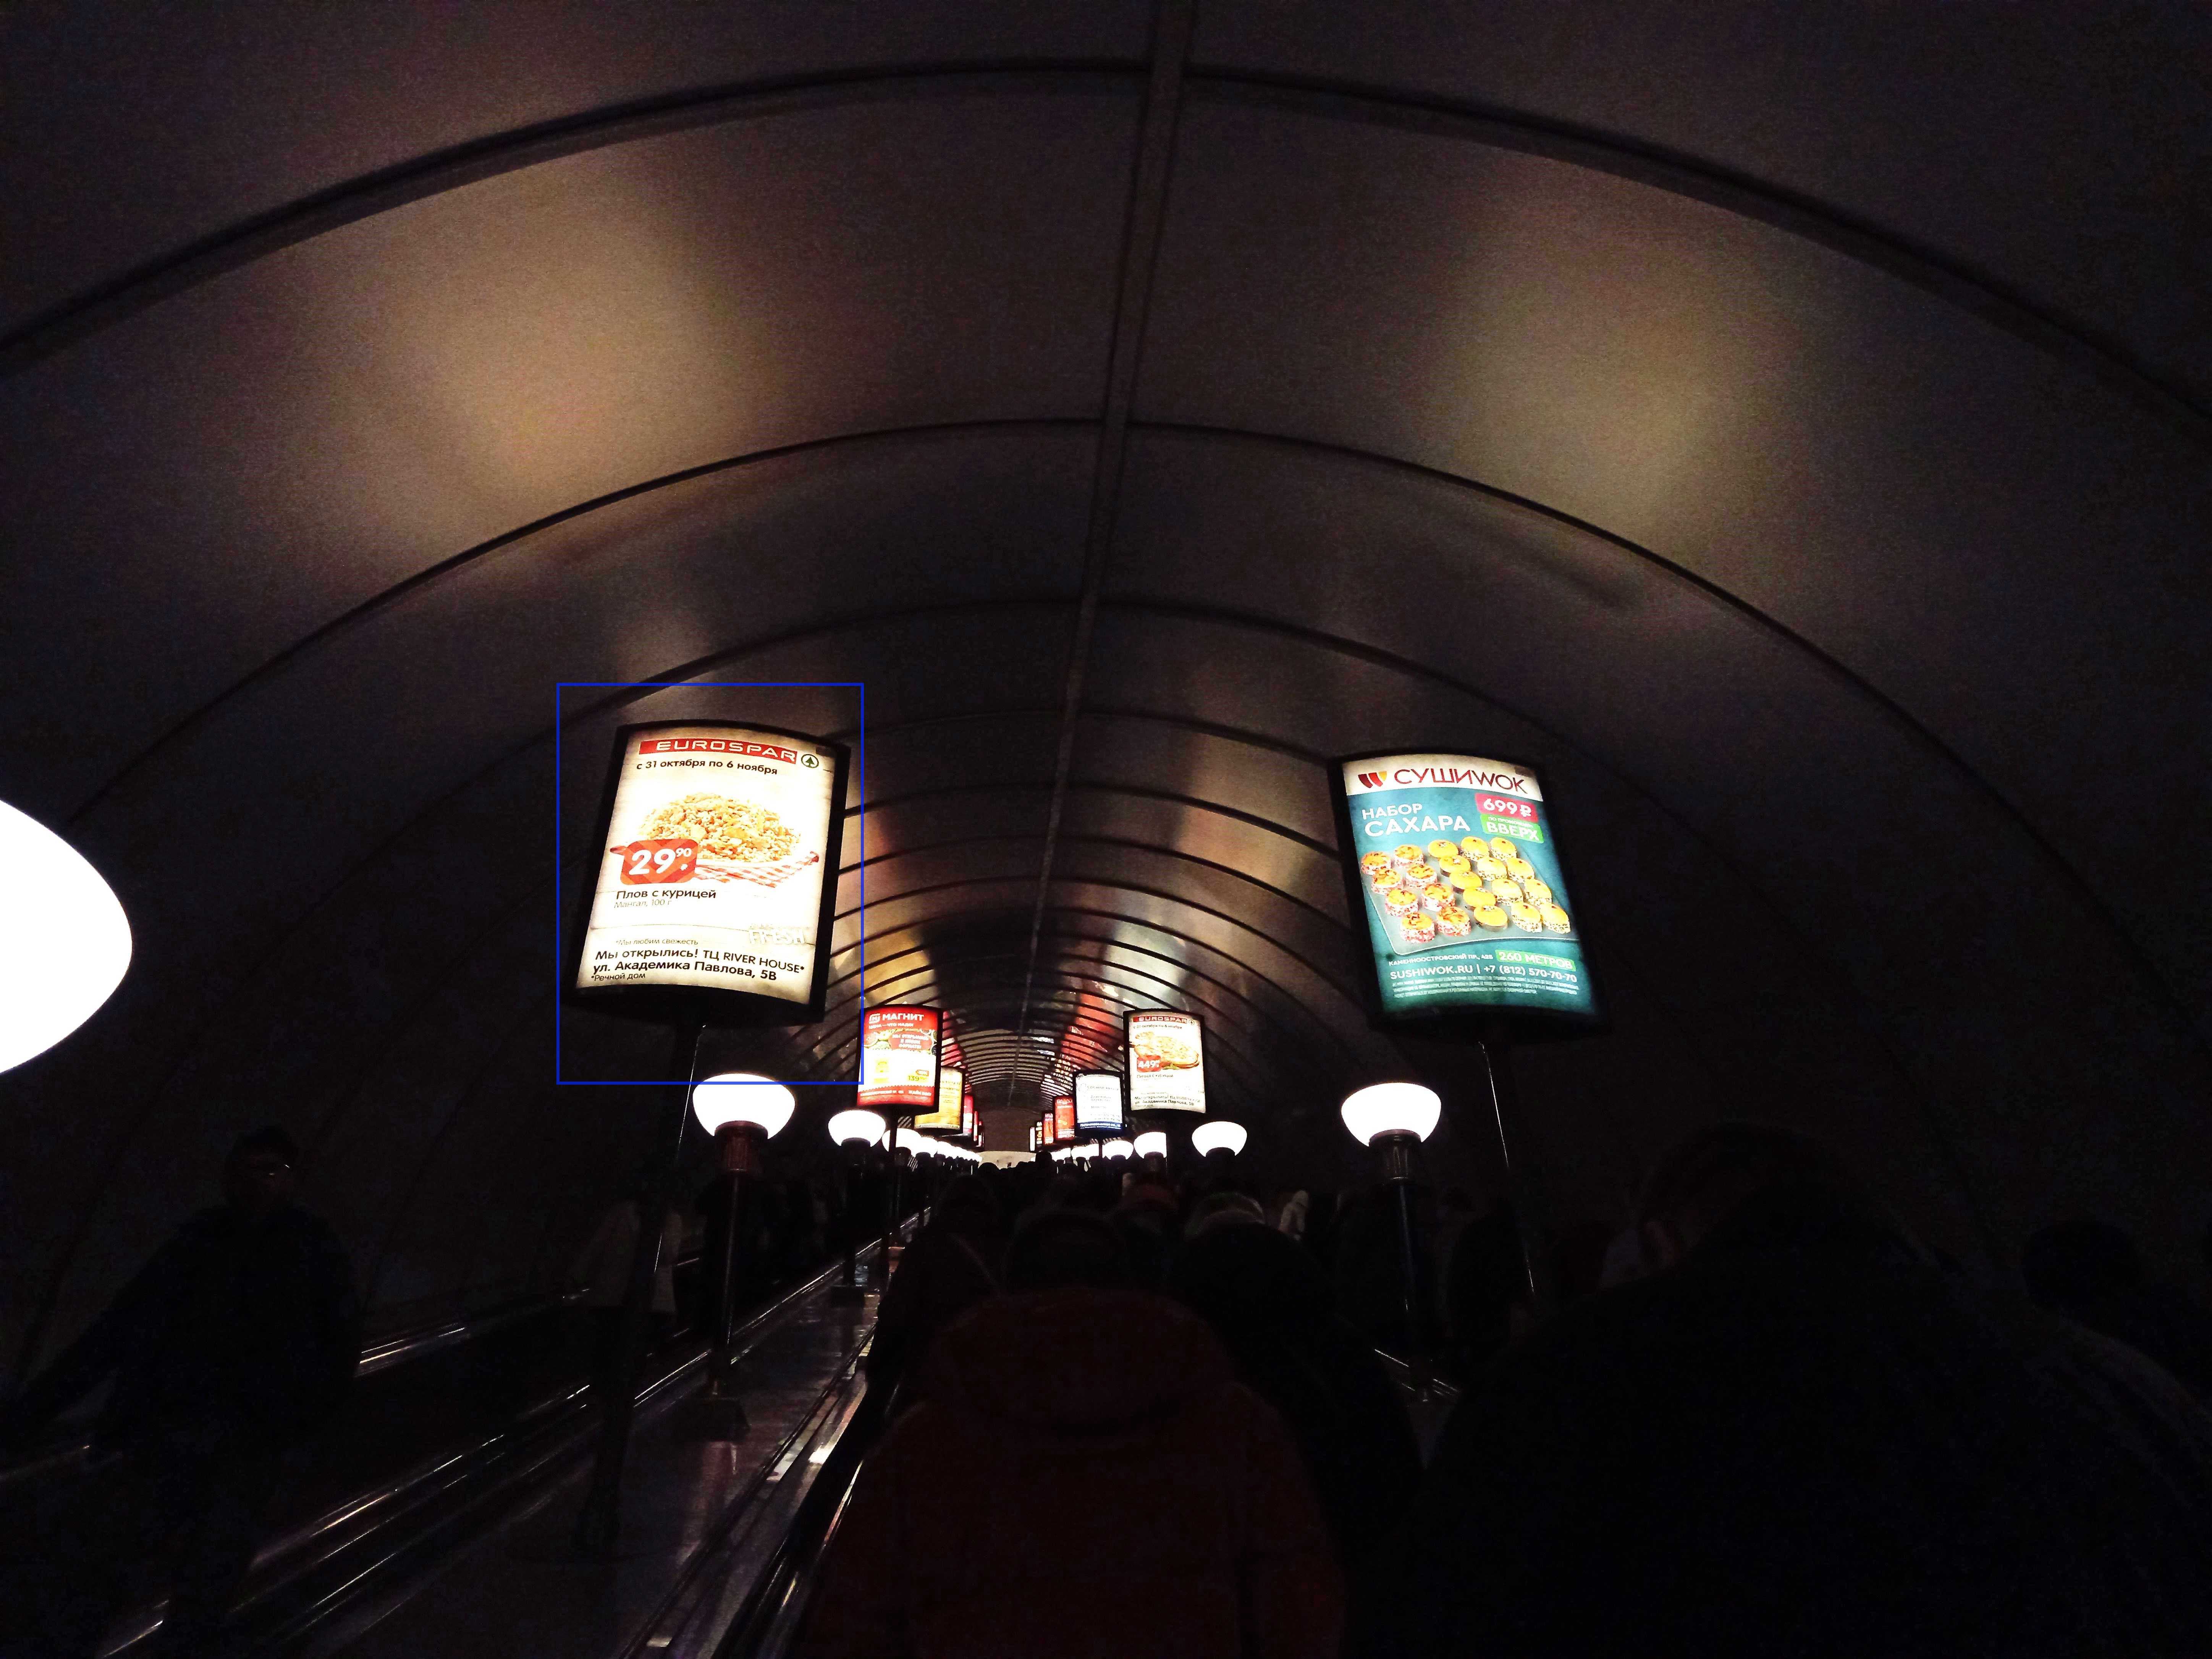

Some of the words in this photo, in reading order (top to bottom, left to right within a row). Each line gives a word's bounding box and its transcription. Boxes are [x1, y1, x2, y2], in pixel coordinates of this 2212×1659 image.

[656, 740, 796, 762] EUROSPAR
[660, 759, 706, 768] октября
[737, 763, 778, 775] ноября
[1361, 803, 1423, 820] НАБОР
[1365, 815, 1471, 837] САХАРА
[1486, 821, 1540, 842] ВВЕРХ
[616, 891, 648, 899] Плов
[662, 890, 716, 899] курицей
[595, 951, 618, 960] Мы
[622, 949, 698, 959] открылись!
[703, 950, 719, 961] ТЦ
[723, 952, 756, 964] RIVER
[1499, 951, 1522, 962] 260
[1525, 953, 1573, 970] МЕТРОВ
[593, 964, 610, 975] ул.
[614, 961, 690, 971] Академика
[694, 961, 755, 978] Павлова,
[760, 969, 777, 981] 5В
[1390, 964, 1473, 980] SUSHIWOK.RU
[1483, 965, 1496, 973] +7
[1499, 965, 1526, 976] (812)
[1528, 967, 1578, 983] 570-70-70
[882, 1013, 924, 1021] МАГНИТ
